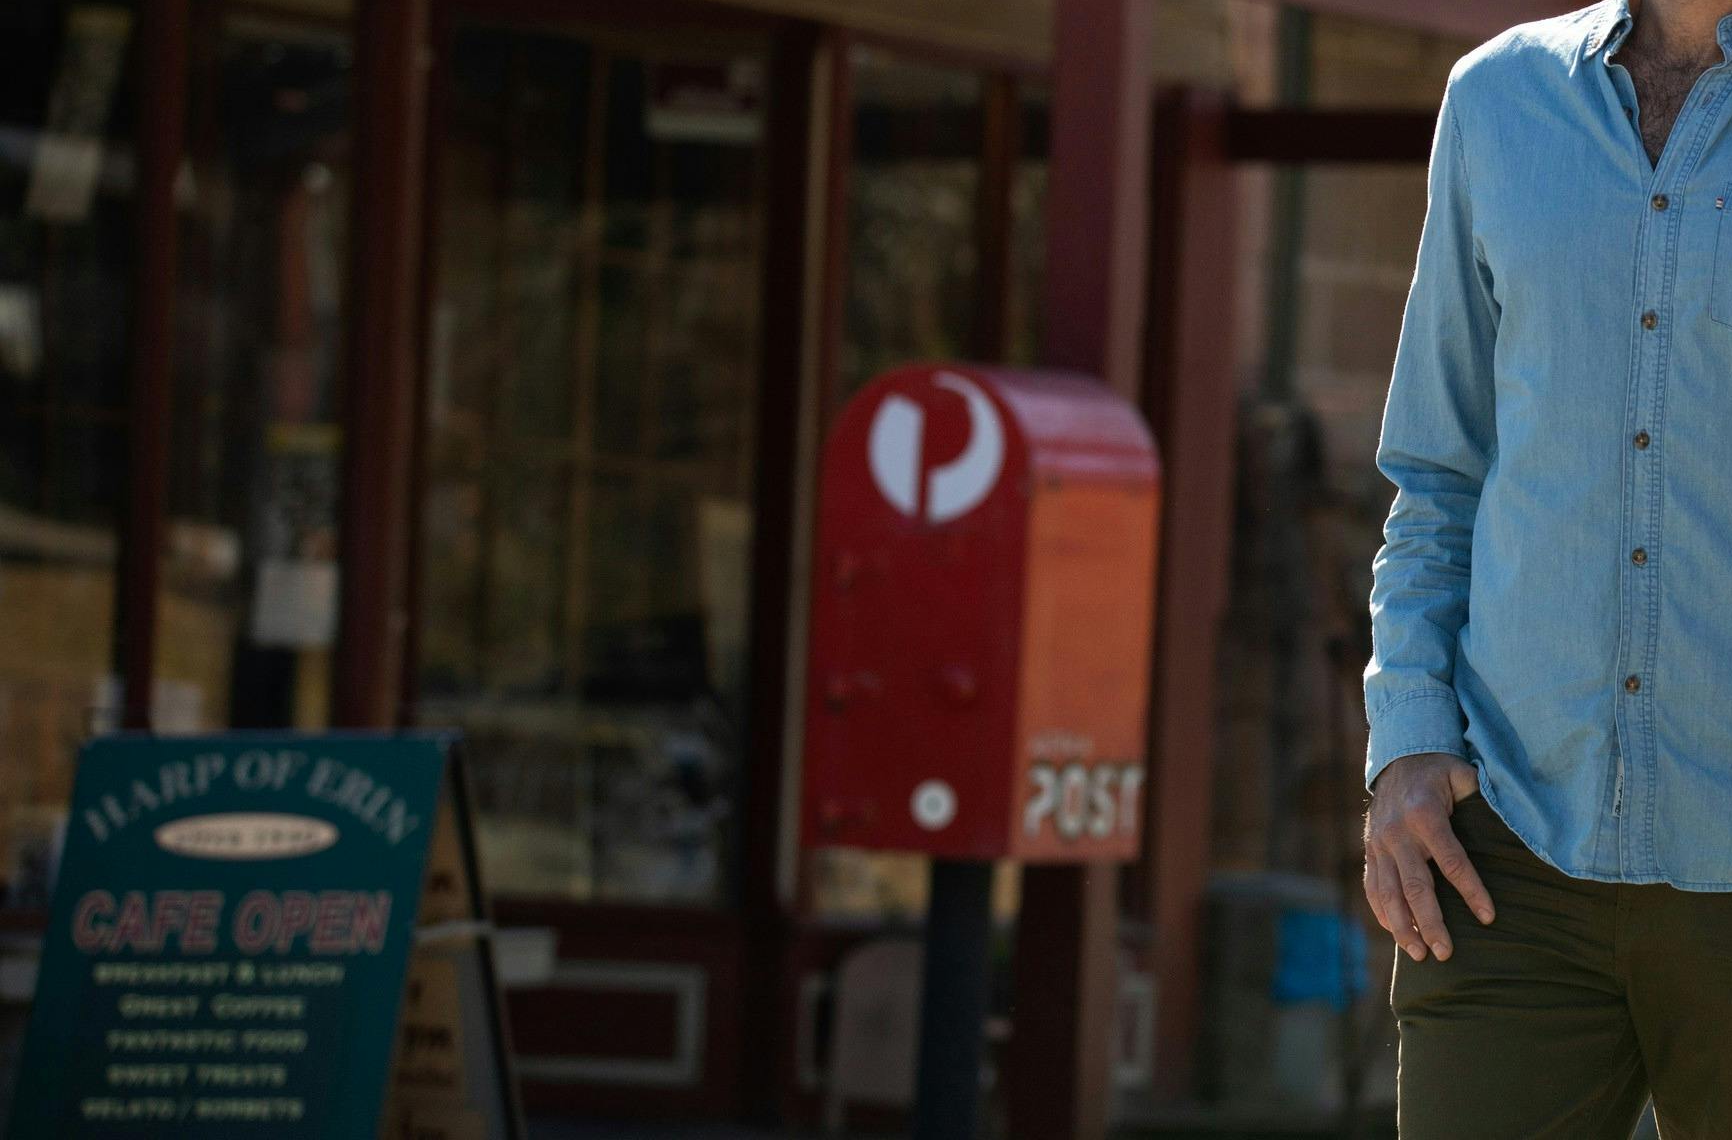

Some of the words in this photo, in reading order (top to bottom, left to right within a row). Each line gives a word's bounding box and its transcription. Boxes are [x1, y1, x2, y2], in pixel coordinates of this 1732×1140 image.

[83, 753, 228, 842] HARP
[234, 749, 307, 791] OF
[307, 757, 420, 844] ERIN
[1023, 763, 1146, 839] POST
[73, 890, 223, 953] CAFE
[234, 890, 390, 953] OPEN
